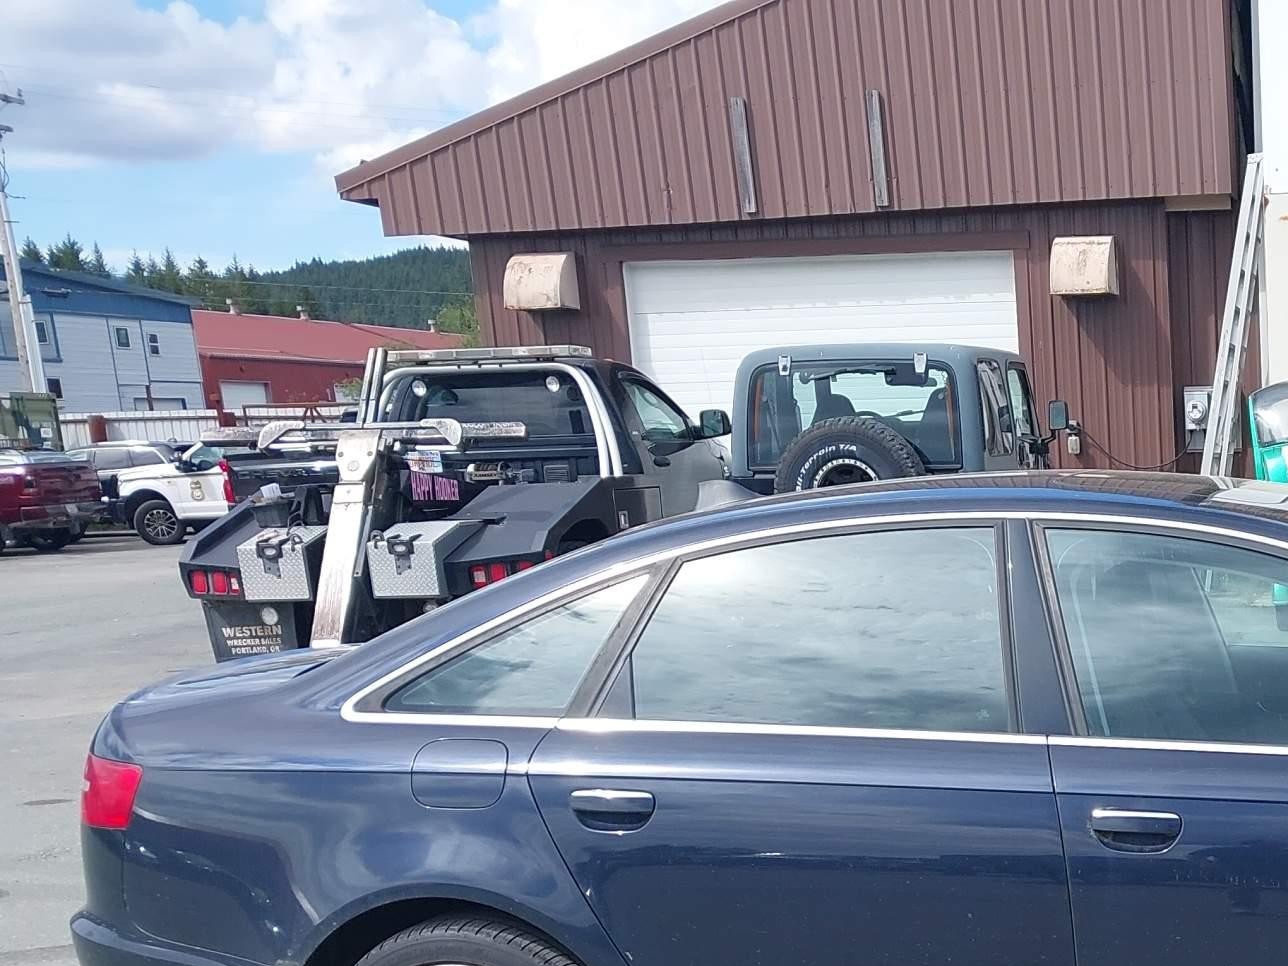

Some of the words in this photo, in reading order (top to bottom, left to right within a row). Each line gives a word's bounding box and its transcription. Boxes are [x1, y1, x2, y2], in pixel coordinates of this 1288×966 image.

[410, 471, 433, 500] HAPPY
[222, 625, 282, 637] WESTERN
[226, 638, 260, 646] WRECKER
[231, 646, 269, 655] PORTLAND,
